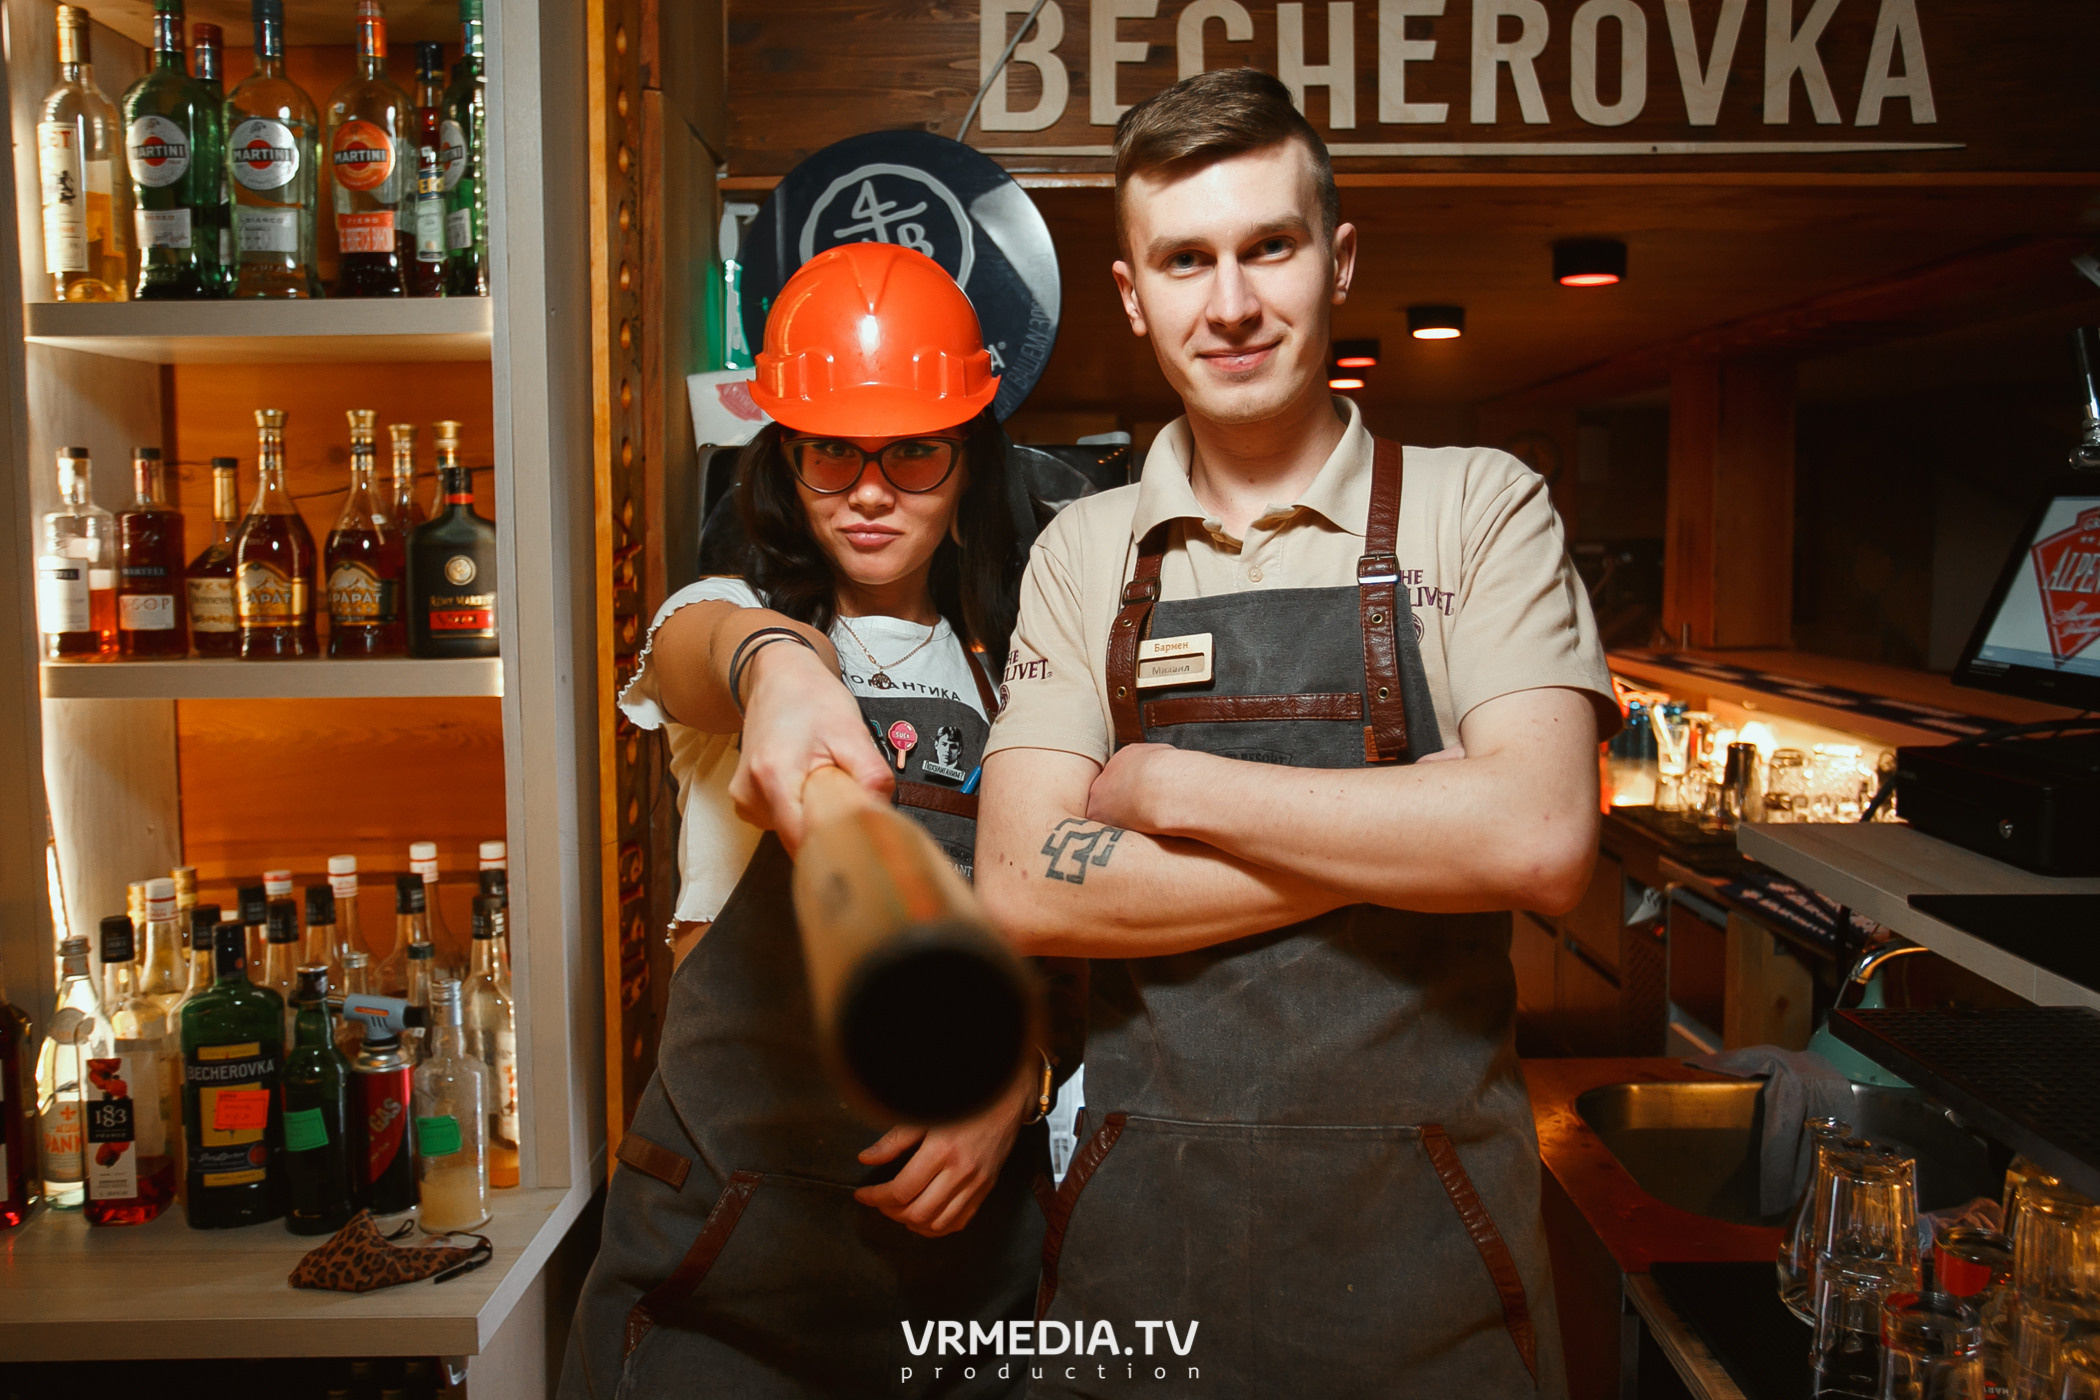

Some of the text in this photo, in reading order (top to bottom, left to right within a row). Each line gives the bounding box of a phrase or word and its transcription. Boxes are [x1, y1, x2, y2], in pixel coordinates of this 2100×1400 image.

[979, 0, 1937, 131] BECHEROVKA
[136, 145, 185, 158] ARTINI
[232, 149, 291, 162] MARTINI
[334, 150, 386, 164] MARTINI
[1154, 641, 1189, 653] Бармен
[1152, 665, 1190, 675] Михаил
[895, 731, 910, 739] SUCK
[187, 1058, 275, 1081] BECHEROVKA
[369, 1097, 403, 1133] GAS
